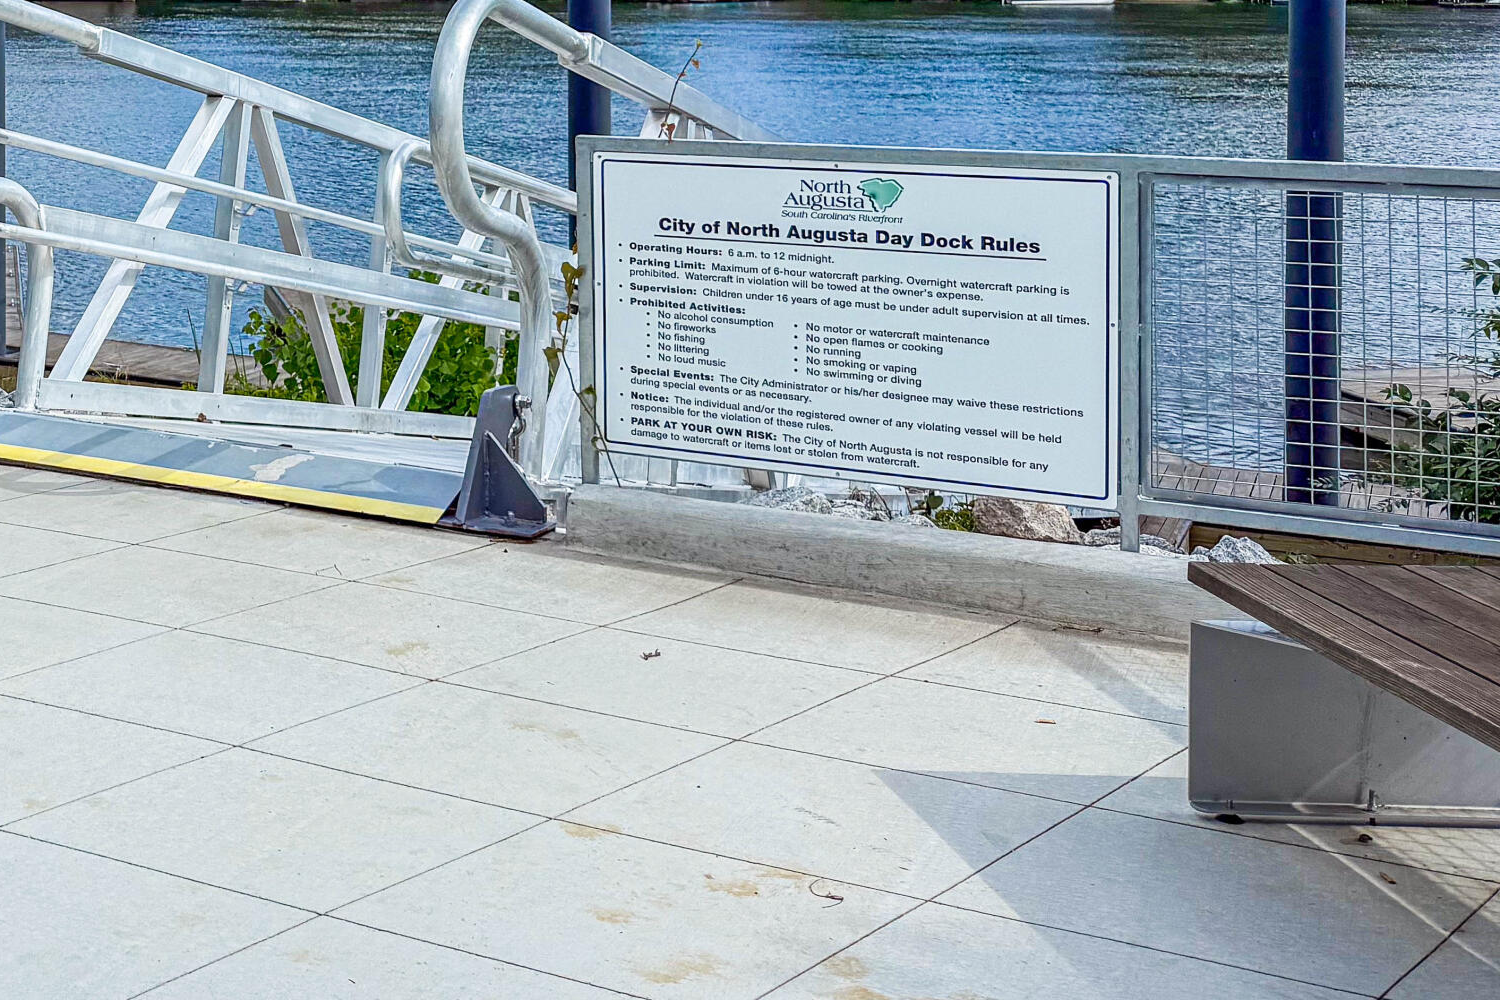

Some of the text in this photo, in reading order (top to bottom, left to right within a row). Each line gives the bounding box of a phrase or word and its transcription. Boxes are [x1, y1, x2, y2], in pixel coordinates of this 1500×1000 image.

[800, 180, 850, 193] North
[784, 192, 866, 208] Augusta
[781, 210, 903, 223] South Carolina's Riverfront
[659, 217, 1040, 253] City of North Augusta Day Dock Rules
[629, 242, 682, 254] Operating
[686, 246, 722, 256] Hours:
[728, 248, 734, 256] 6
[760, 251, 770, 259] to
[773, 251, 785, 260] 12
[788, 253, 834, 264] midnight.
[629, 257, 1069, 296] Parking Limit: Maximum of 6-hour watercraft parking. Overnight watercraft parking is
[629, 268, 983, 301] prohibited. Watercraft in violation will be towed at the owner's expense.
[630, 282, 1089, 325] Supervision: Children under 16 years of age must be under adult supervision at all times.
[630, 297, 745, 314] Prohibited Activities:
[658, 310, 773, 328] No alcohol consumption
[658, 321, 716, 333] No fireworks
[658, 331, 705, 345] No fishing
[806, 322, 820, 331] No
[823, 325, 853, 334] motor
[869, 329, 919, 340] watercraft
[923, 333, 989, 345] maintenance
[806, 333, 820, 342] No
[823, 337, 848, 345] open
[851, 337, 885, 348] flames
[901, 343, 943, 355] cooking
[658, 342, 709, 356] No littering
[658, 352, 726, 367] No loud music
[806, 344, 861, 359] No running
[806, 356, 820, 365] No
[823, 359, 866, 371] smoking
[883, 364, 916, 375] vaping
[806, 367, 820, 376] No
[823, 369, 874, 383] swimming
[890, 375, 921, 387] diving
[630, 376, 660, 388] during
[662, 381, 695, 390] special
[698, 384, 729, 394] events
[759, 391, 812, 403] necessary.
[630, 365, 1083, 417] Special Events: The City Administrator or his/her designee may waive these restrictions
[631, 391, 1061, 443] Notice: The individual and/or the registered owner of any violating vessel will be held
[631, 403, 833, 431] responsible for the violation of these rules.
[631, 417, 1048, 472] PARK AT YOUR OWN RISK: The City of North Augusta is not responsible for any
[631, 428, 667, 439] damage
[683, 435, 728, 446] watercraft
[745, 441, 770, 450] items
[774, 444, 790, 453] lost
[808, 449, 837, 458] stolen
[841, 451, 863, 461] from
[867, 456, 919, 467] watercraft.
